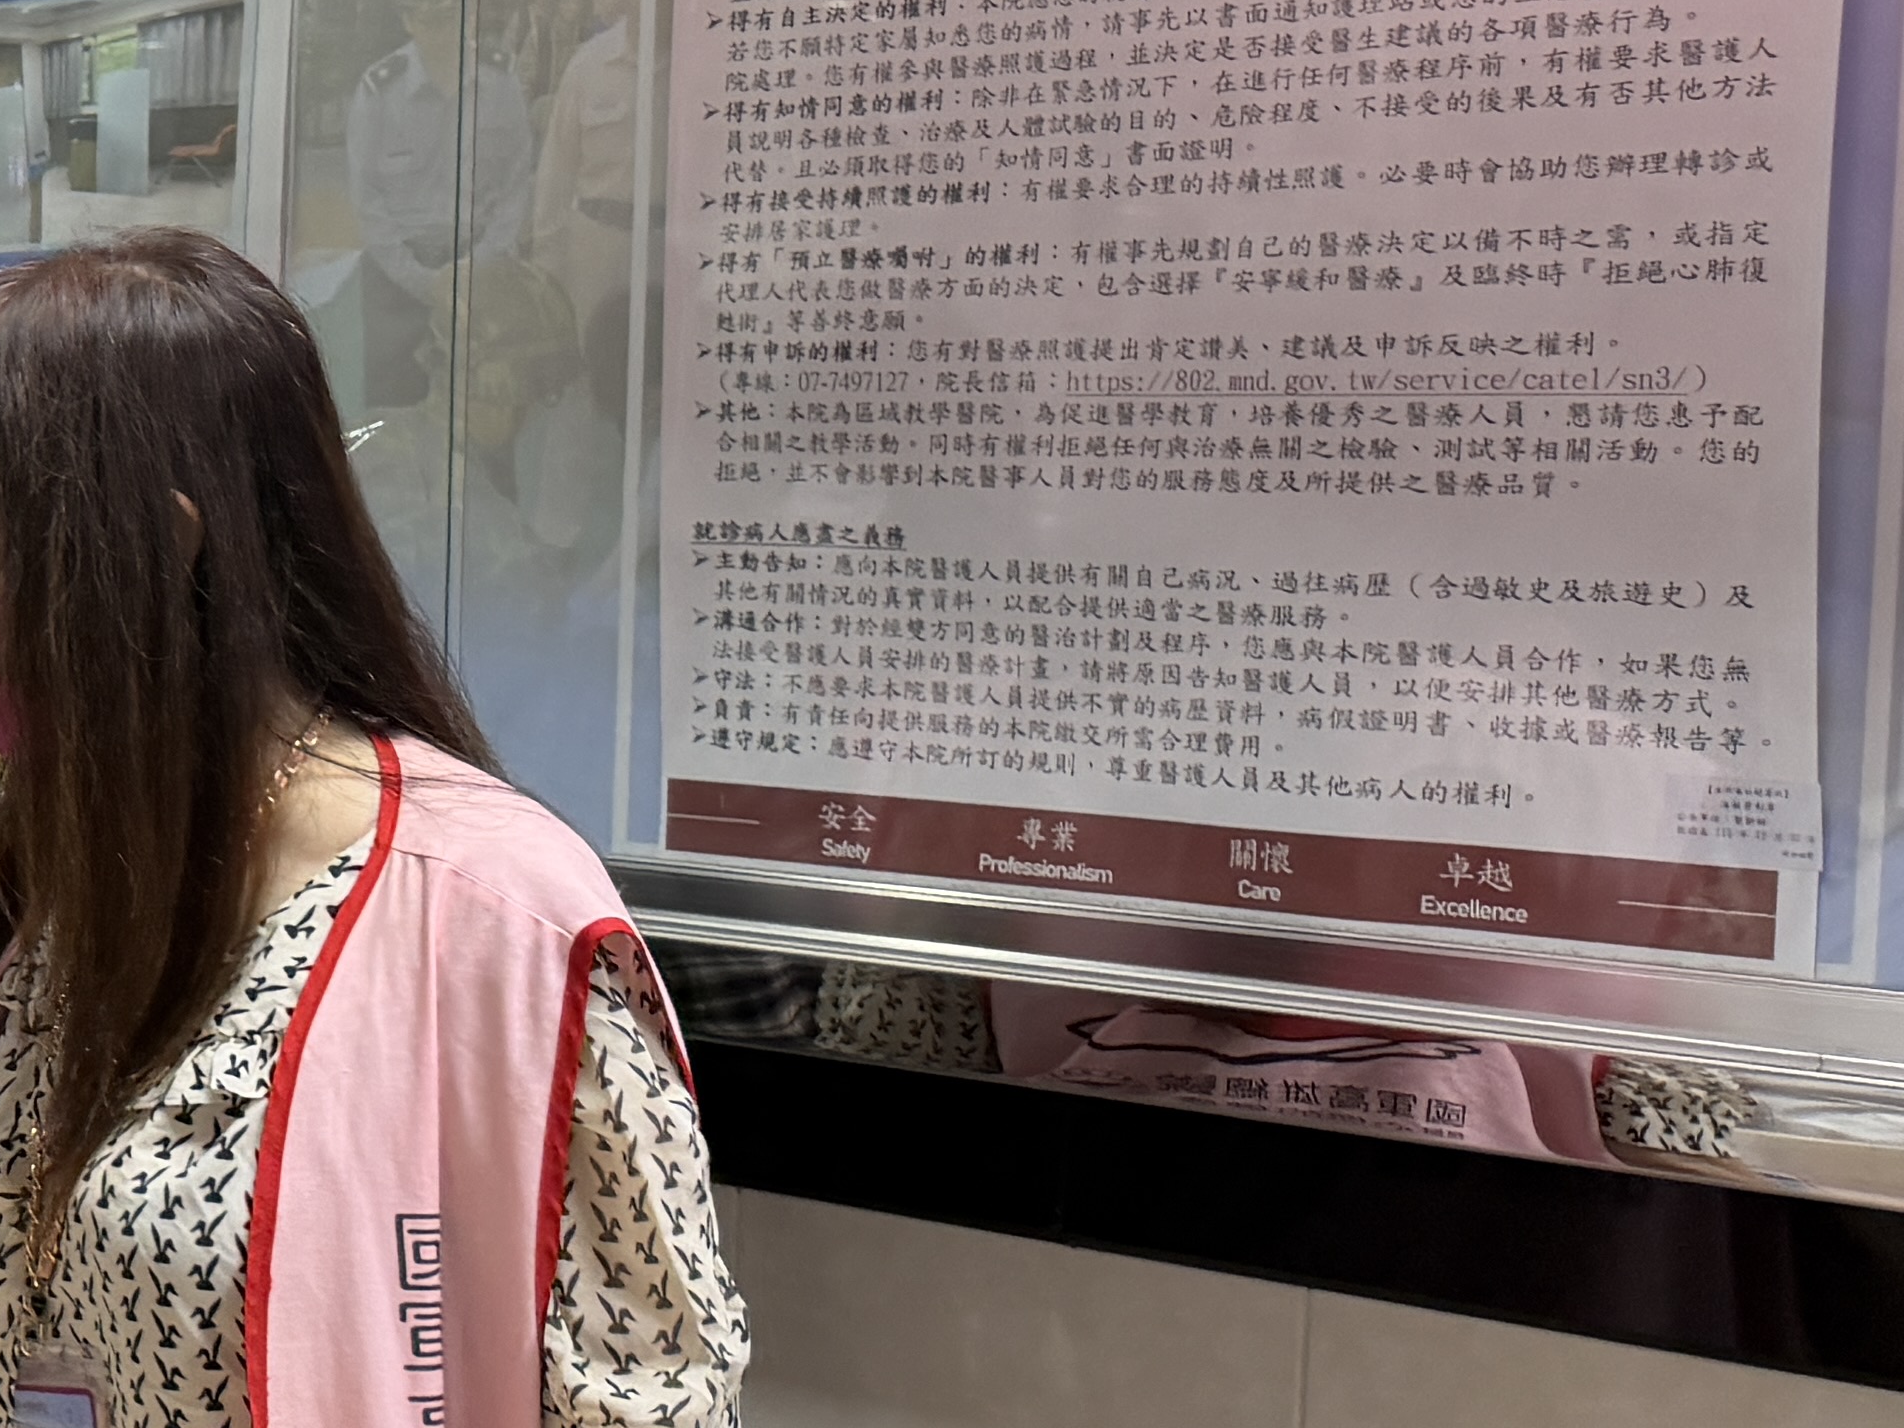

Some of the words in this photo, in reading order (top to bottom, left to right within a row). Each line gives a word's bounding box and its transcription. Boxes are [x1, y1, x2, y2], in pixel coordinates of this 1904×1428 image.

[719, 218, 880, 243] 安排居家護理。
[819, 801, 876, 833] 安全
[821, 838, 870, 863] Safety
[1017, 819, 1078, 853] 專業
[979, 852, 1113, 885] Professionalism
[1230, 838, 1293, 875] 關懷
[1439, 853, 1513, 891] 卓越
[1238, 879, 1281, 904] Care
[1420, 895, 1529, 925] Excellence
